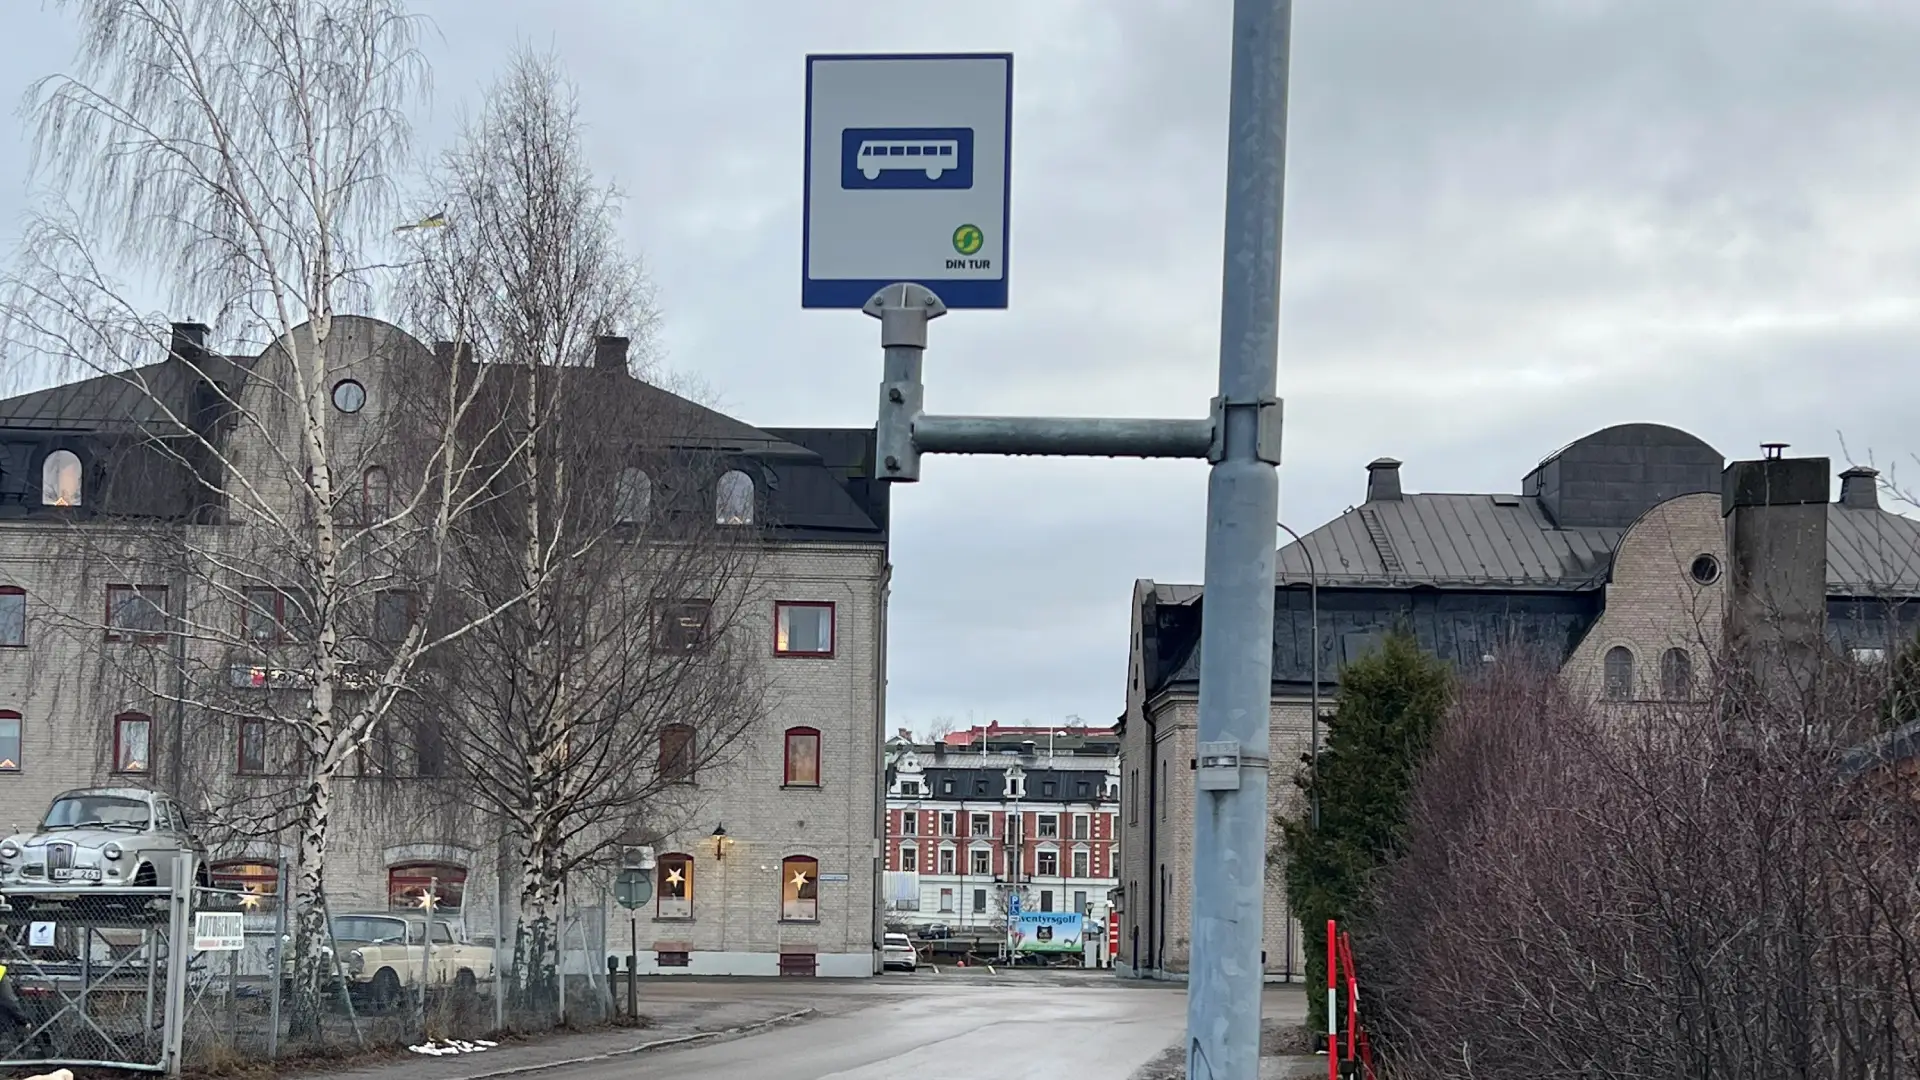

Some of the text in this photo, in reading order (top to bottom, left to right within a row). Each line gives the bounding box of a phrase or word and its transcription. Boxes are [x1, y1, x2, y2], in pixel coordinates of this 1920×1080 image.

[946, 259, 991, 269] DIN TUR
[197, 915, 242, 937] AUTOSERVICE
